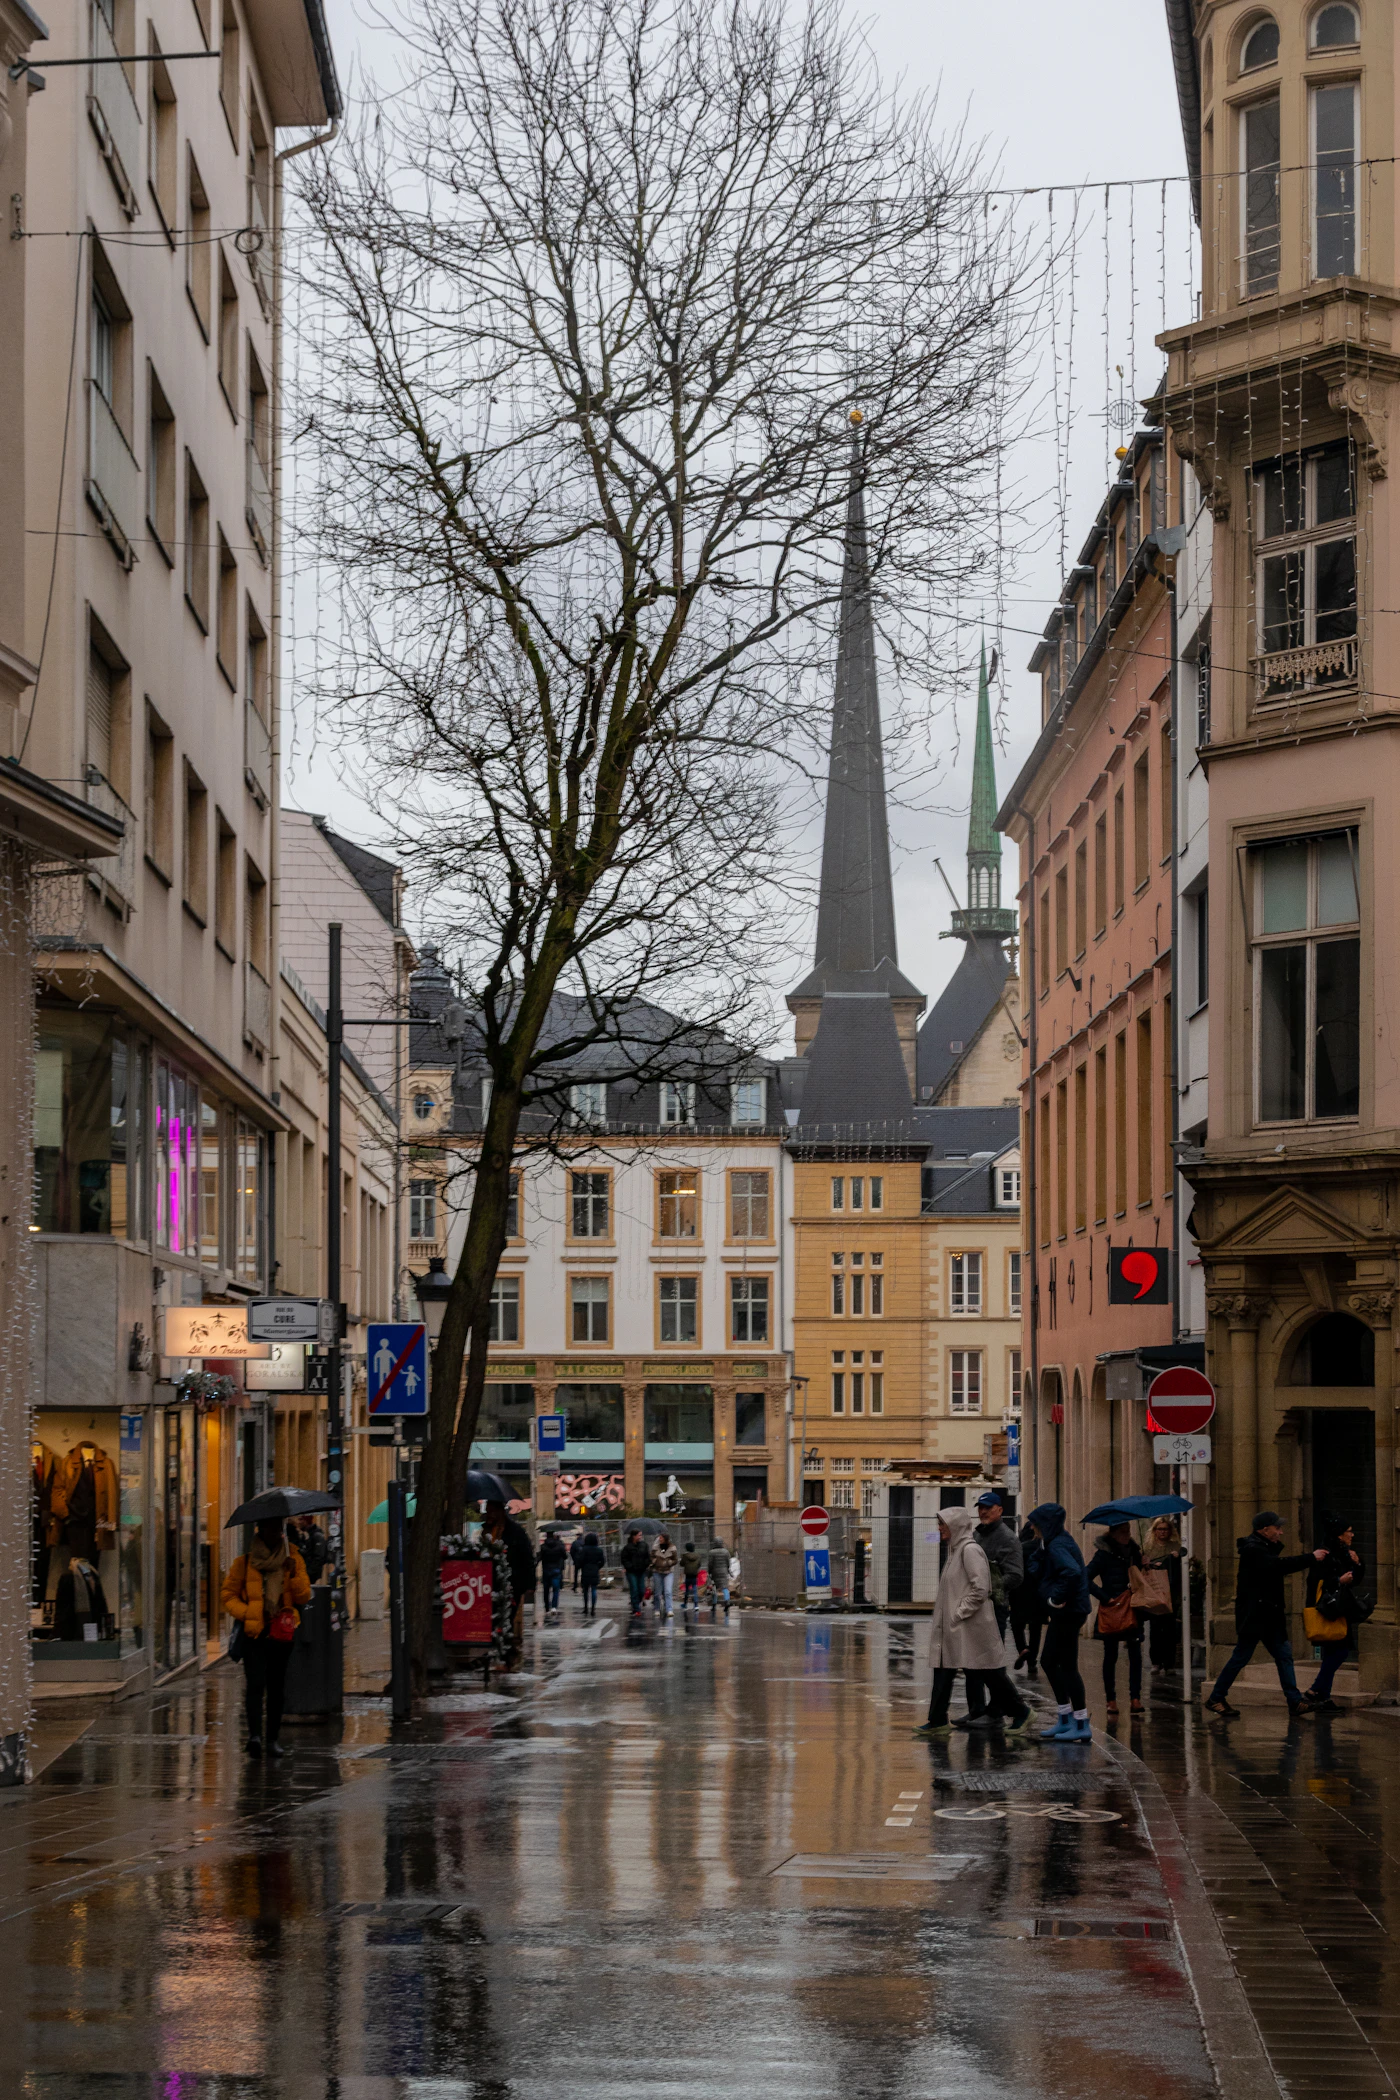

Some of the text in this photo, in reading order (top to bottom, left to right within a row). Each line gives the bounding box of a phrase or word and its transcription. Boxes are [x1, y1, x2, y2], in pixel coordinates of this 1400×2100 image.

[246, 1370, 304, 1379] GORALSKA
[486, 1365, 525, 1376] MAISON
[576, 1365, 624, 1376] LASSNER
